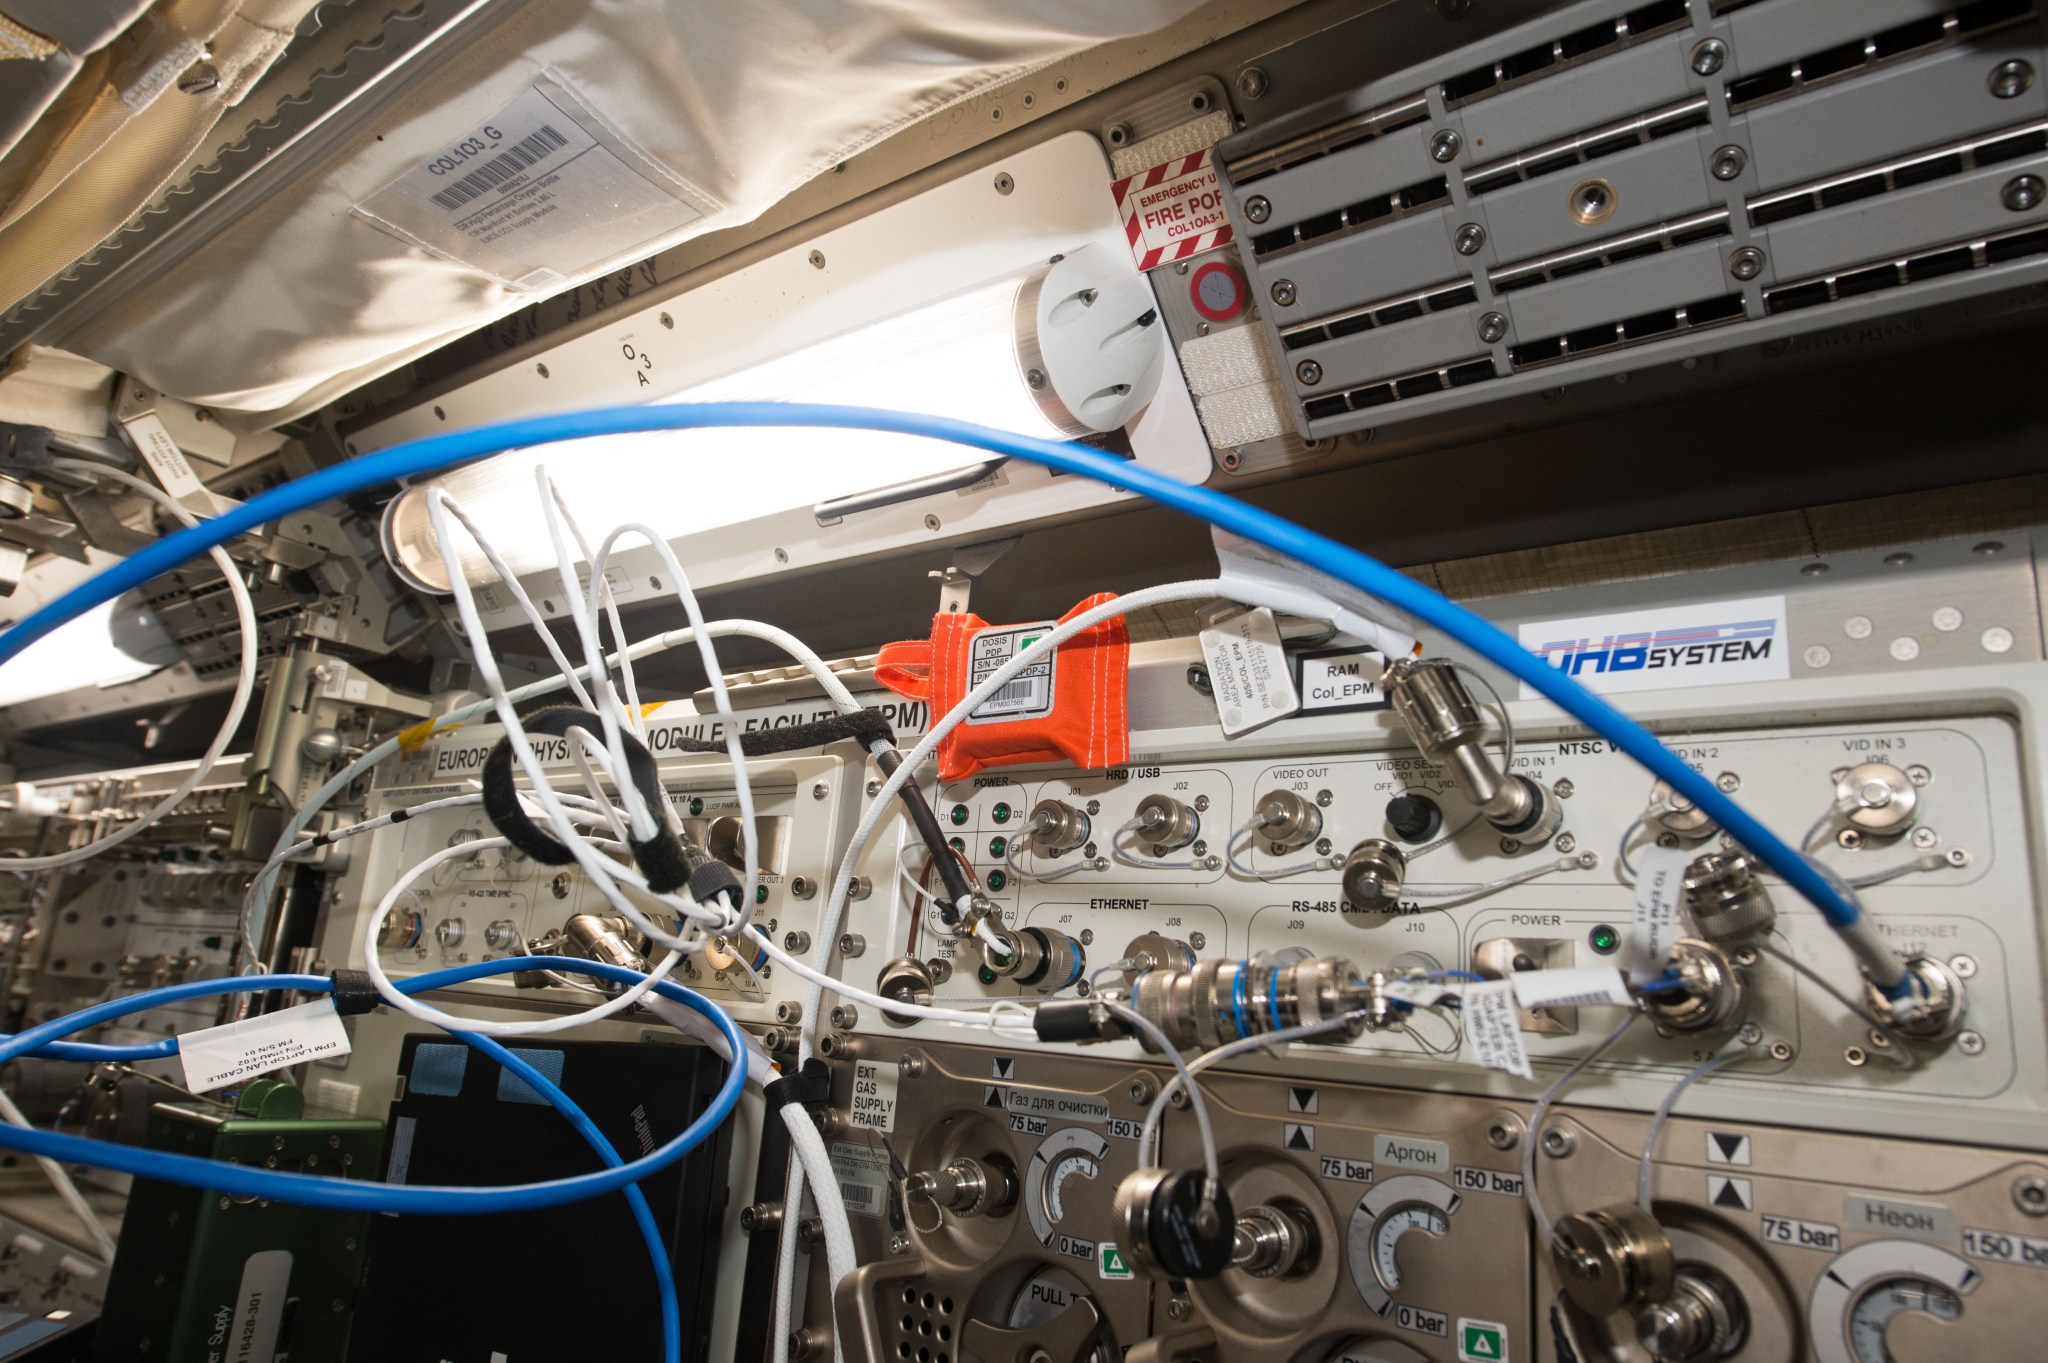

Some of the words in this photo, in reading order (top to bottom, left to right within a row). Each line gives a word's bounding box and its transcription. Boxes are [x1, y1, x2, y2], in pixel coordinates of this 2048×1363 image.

[1140, 176, 1205, 208] EMERGENCY
[469, 216, 484, 226] High
[484, 199, 516, 218] Percentage
[516, 186, 540, 201] Oxygen
[539, 174, 560, 188] Bottle
[1144, 203, 1185, 229] FIRE
[513, 216, 534, 230] Supply
[982, 637, 1007, 648] DOSIS
[986, 647, 1002, 657] PDP
[1648, 638, 1772, 669] SYSTEM
[977, 659, 991, 669] S/N
[1218, 643, 1236, 688] MONITOR
[1327, 663, 1359, 678] RAM
[1215, 655, 1231, 702] RADIATION
[1262, 666, 1271, 680] S/N
[1312, 682, 1374, 700] Col_EPM
[989, 699, 1025, 709] EPM00756E
[1261, 693, 1270, 709] P/N
[1558, 742, 1603, 756] NTSC
[1842, 739, 1872, 751] VID
[1875, 739, 1893, 750] IN
[1897, 738, 1907, 749] 3
[1691, 749, 1708, 759] IN
[1710, 747, 1719, 758] 2
[1376, 761, 1410, 771] VIDEO
[1533, 756, 1546, 768] IN
[1550, 755, 1555, 767] 1
[1106, 769, 1130, 781] HRD
[1138, 767, 1161, 779] USB
[1273, 769, 1304, 780] VIDEO
[1306, 767, 1329, 778] OUT
[1392, 771, 1413, 781] VID1
[1420, 769, 1441, 780] VID2
[445, 784, 461, 792] PANEL
[974, 776, 1009, 788] POWER
[1173, 781, 1189, 791] J02
[1291, 781, 1308, 791] J03
[1374, 782, 1393, 792] OFF
[1068, 787, 1082, 796] J01
[678, 794, 685, 803] 10
[940, 813, 949, 822] D1
[1012, 810, 1023, 819] D2
[767, 876, 779, 884] OUT
[1008, 877, 1017, 887] F2
[1090, 898, 1150, 911] ETHERNET
[1292, 900, 1338, 913] RS-485
[930, 911, 940, 920] G1
[1004, 911, 1015, 920] G2
[1058, 914, 1073, 924] J07
[1165, 917, 1182, 927] J08
[1511, 914, 1561, 926] POWER
[1287, 919, 1305, 930] J09
[1405, 921, 1426, 933] J10
[937, 939, 958, 949] LAMP
[937, 949, 956, 959] TEST
[315, 1041, 337, 1052] EPM
[1501, 1014, 1520, 1068] LAPTOP
[258, 1044, 277, 1053] S/N
[271, 1048, 312, 1064] LAPTOP
[246, 1062, 268, 1072] LAN
[857, 1066, 877, 1079] EXT
[206, 1067, 244, 1083] CABLE
[855, 1081, 877, 1095] GAS
[854, 1097, 893, 1113] SUPPLY
[1009, 1090, 1031, 1107] Газ
[1032, 1095, 1055, 1112] для
[1057, 1099, 1108, 1117] очистки
[852, 1112, 887, 1128] FRAME
[1010, 1114, 1025, 1129] 75
[1027, 1116, 1047, 1134] bar
[630, 1104, 656, 1155] hinkPad
[1107, 1119, 1132, 1137] 150
[853, 1148, 871, 1158] Supply
[1385, 1142, 1437, 1164] Аргон
[1322, 1158, 1341, 1174] 75
[1345, 1161, 1373, 1180] bar
[1455, 1168, 1487, 1188] 150
[1491, 1172, 1523, 1194] bar
[1865, 1203, 1935, 1232] Неон
[1762, 1216, 1792, 1240] 75
[1799, 1220, 1840, 1247] bar
[1060, 1237, 1069, 1252] 0
[1071, 1239, 1093, 1258] bar
[1965, 1231, 2013, 1258] 150
[1031, 1284, 1067, 1307] PULL
[207, 1305, 232, 1345] Supply
[1399, 1308, 1410, 1325] 0
[1415, 1309, 1444, 1332] bar
